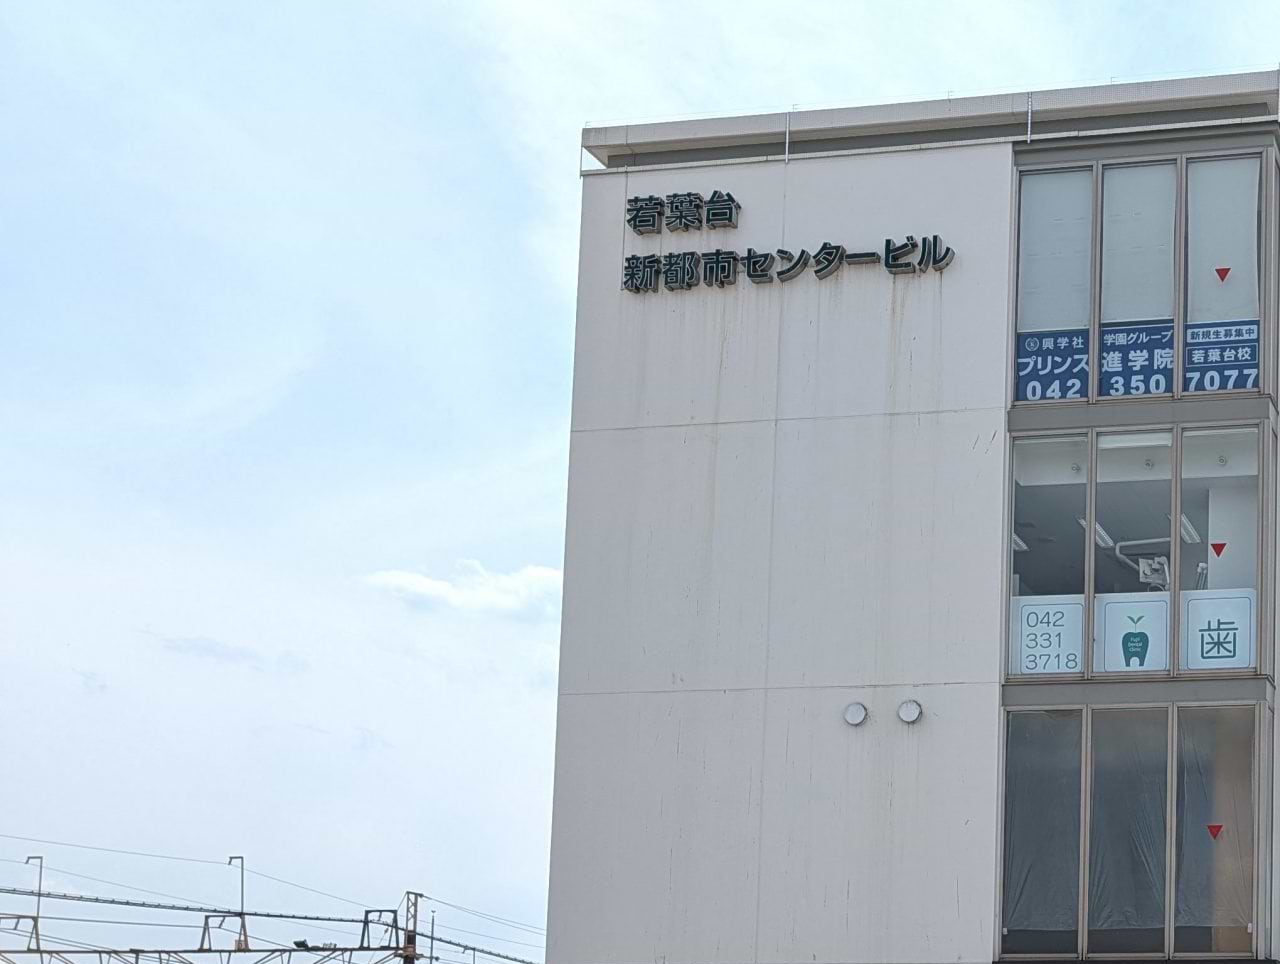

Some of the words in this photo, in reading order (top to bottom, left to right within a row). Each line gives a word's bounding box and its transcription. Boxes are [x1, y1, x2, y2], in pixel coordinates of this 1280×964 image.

[627, 189, 742, 236] 若葉台
[622, 233, 956, 294] 新都市センタービル
[1042, 336, 1084, 350] 興学社
[1103, 330, 1174, 346] 学園グループ
[1190, 327, 1256, 341] 新規生募集中
[1017, 354, 1090, 377] プリンス
[1101, 348, 1174, 373] 進学院
[1191, 346, 1252, 363] 若葉台校
[1026, 378, 1081, 401] 042
[1110, 374, 1166, 396] 350
[1186, 368, 1259, 392] 7077
[1026, 610, 1065, 628] 042
[1025, 632, 1063, 650] 331
[1198, 619, 1239, 660] 歯
[1025, 653, 1078, 671] 3718
